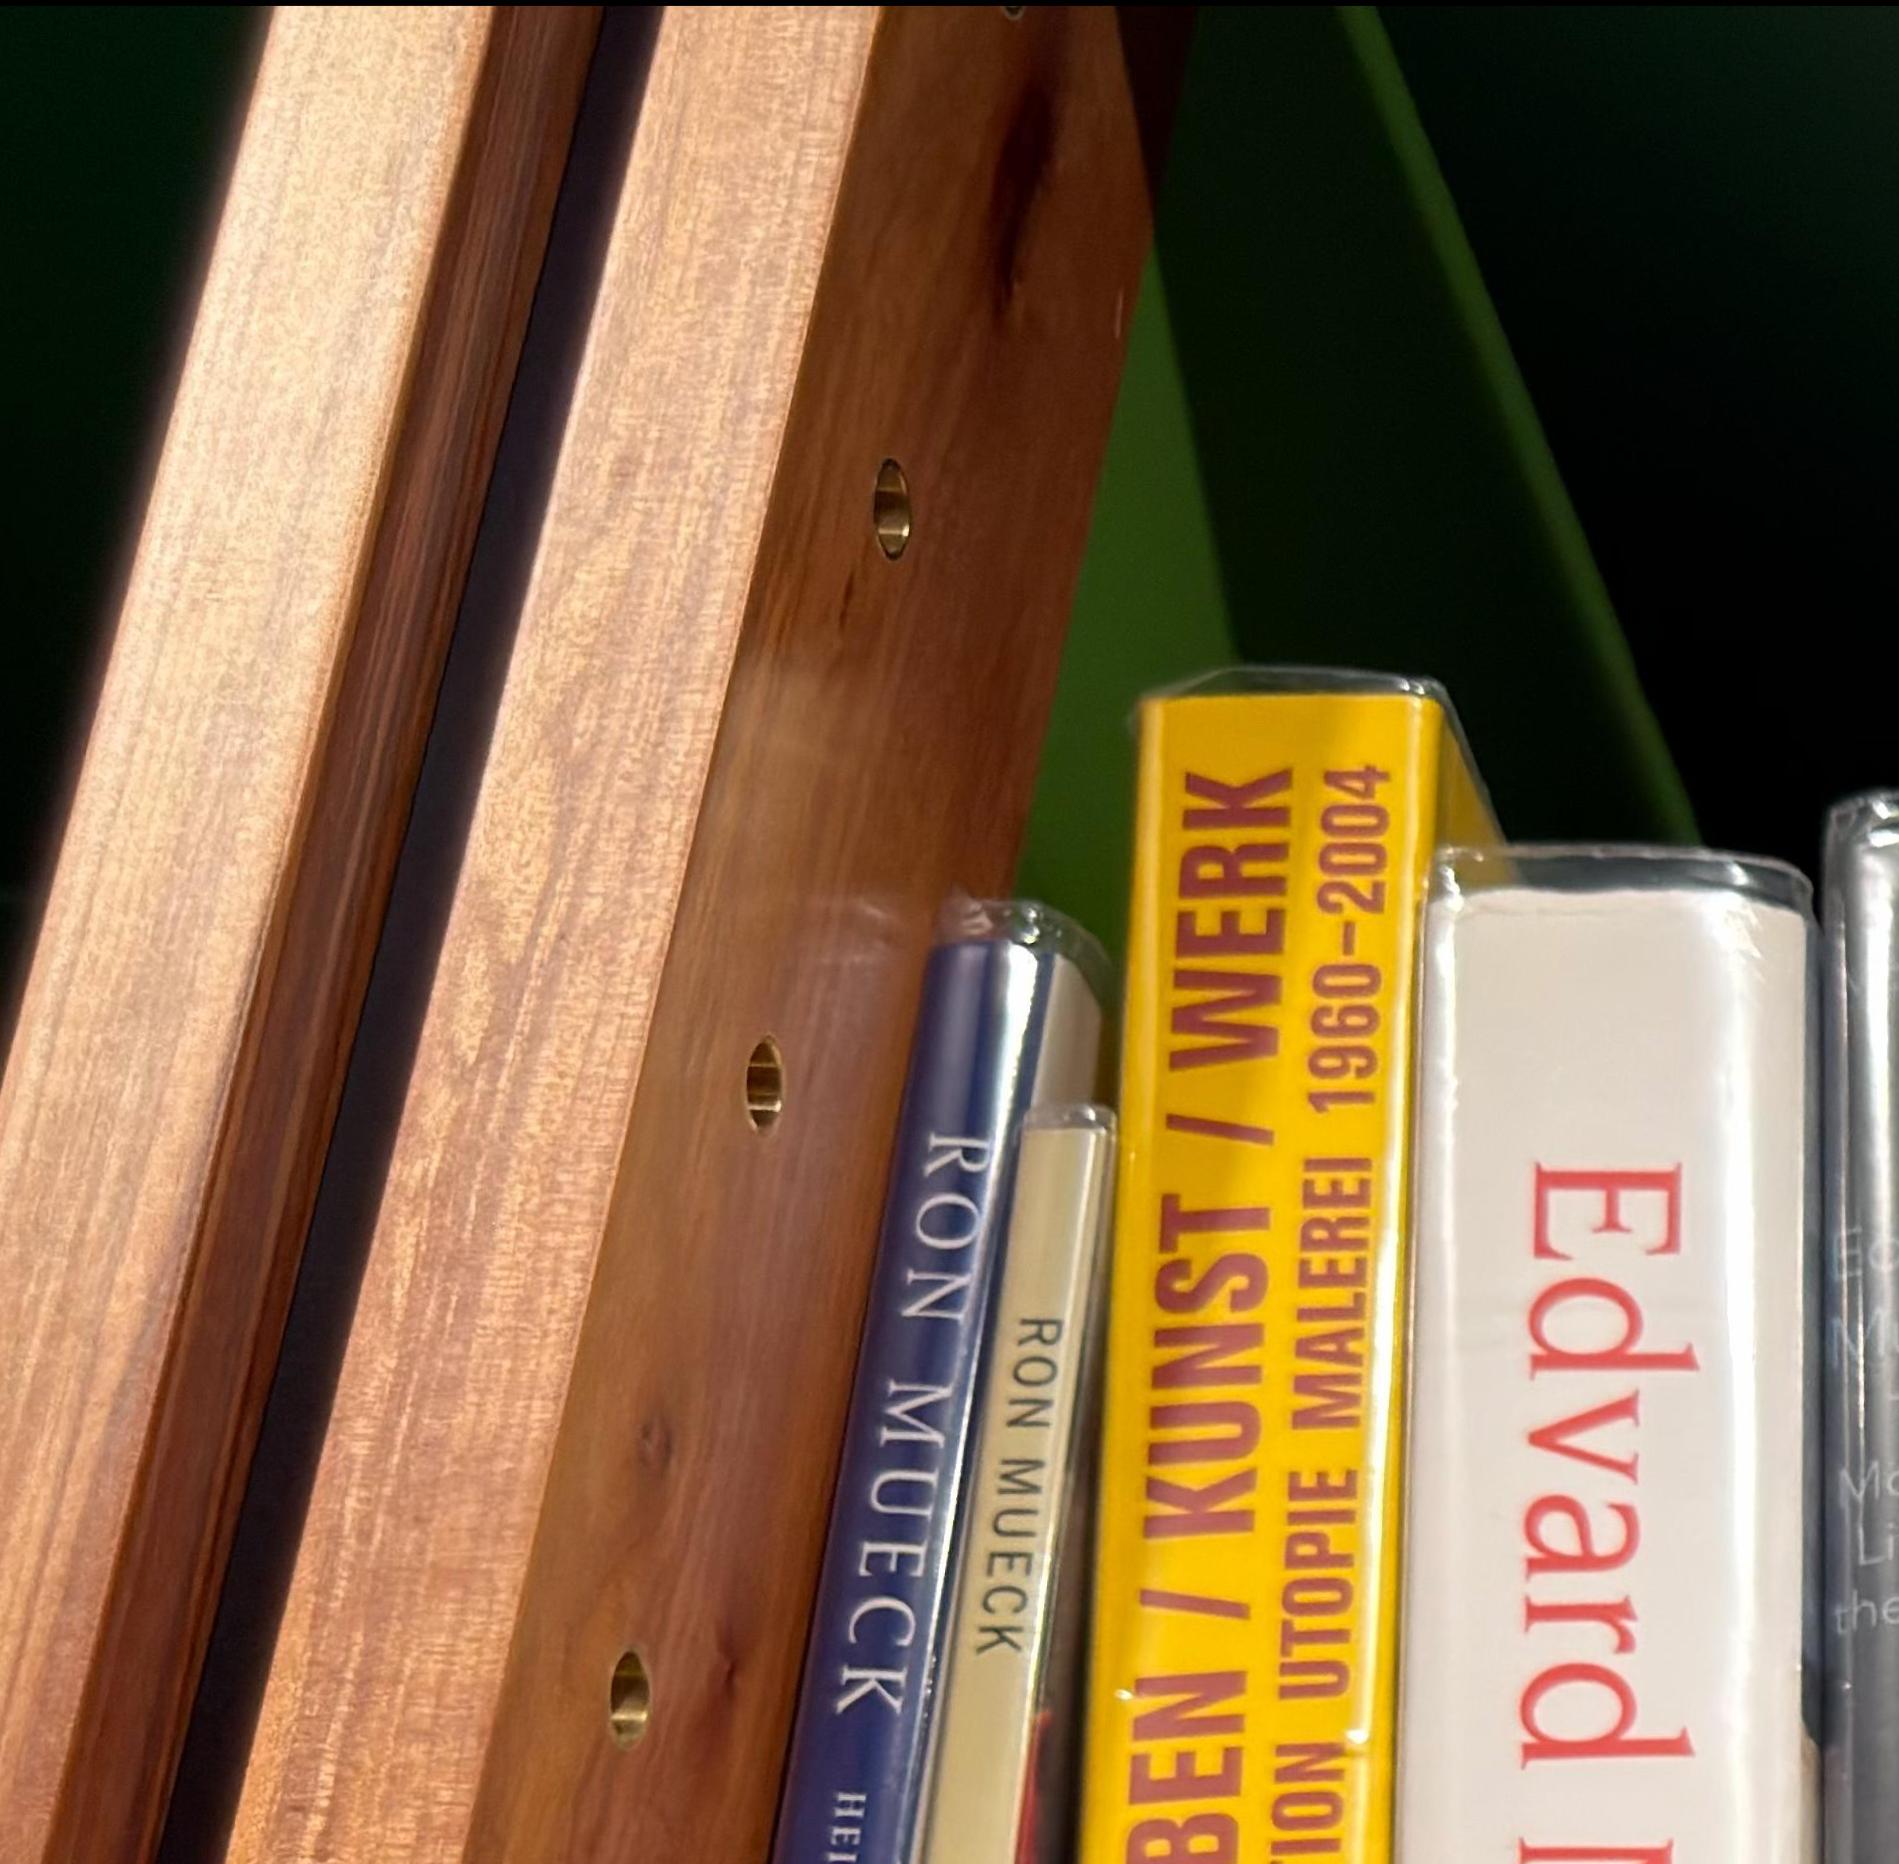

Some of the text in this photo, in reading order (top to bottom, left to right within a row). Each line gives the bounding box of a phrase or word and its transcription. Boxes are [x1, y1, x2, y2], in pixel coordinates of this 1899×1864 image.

[1169, 769, 1293, 1071] WERK
[834, 1132, 989, 1718] RON MUECK
[1143, 1193, 1272, 1541] KUNST
[1293, 1157, 1373, 1429] MALEREI
[974, 1316, 1064, 1656] RON MUECK
[1279, 1469, 1358, 1700] UTOPIE
[1519, 1162, 1700, 1769] Edvard
